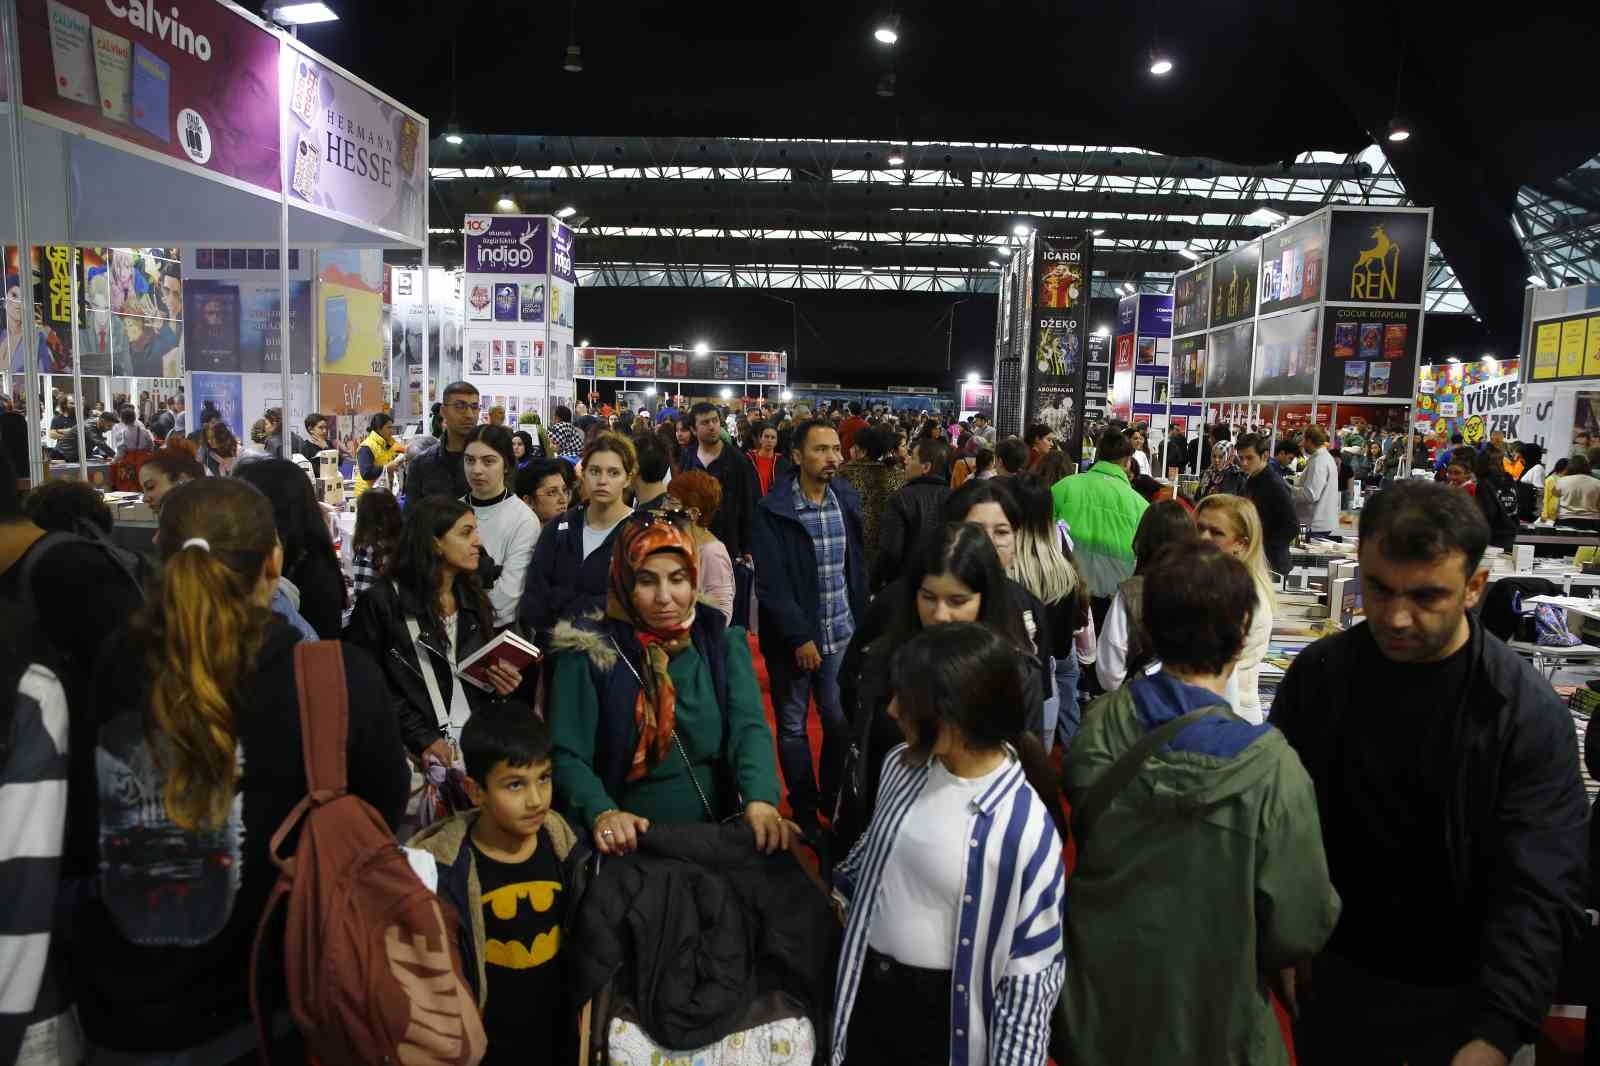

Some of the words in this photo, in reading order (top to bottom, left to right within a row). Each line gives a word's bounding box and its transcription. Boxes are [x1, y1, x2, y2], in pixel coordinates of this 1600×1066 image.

[327, 109, 393, 153] HERMANN
[326, 130, 393, 188] HESSE
[477, 243, 532, 268] indigo
[1042, 251, 1081, 261] ICARDI
[1351, 272, 1399, 300] REN
